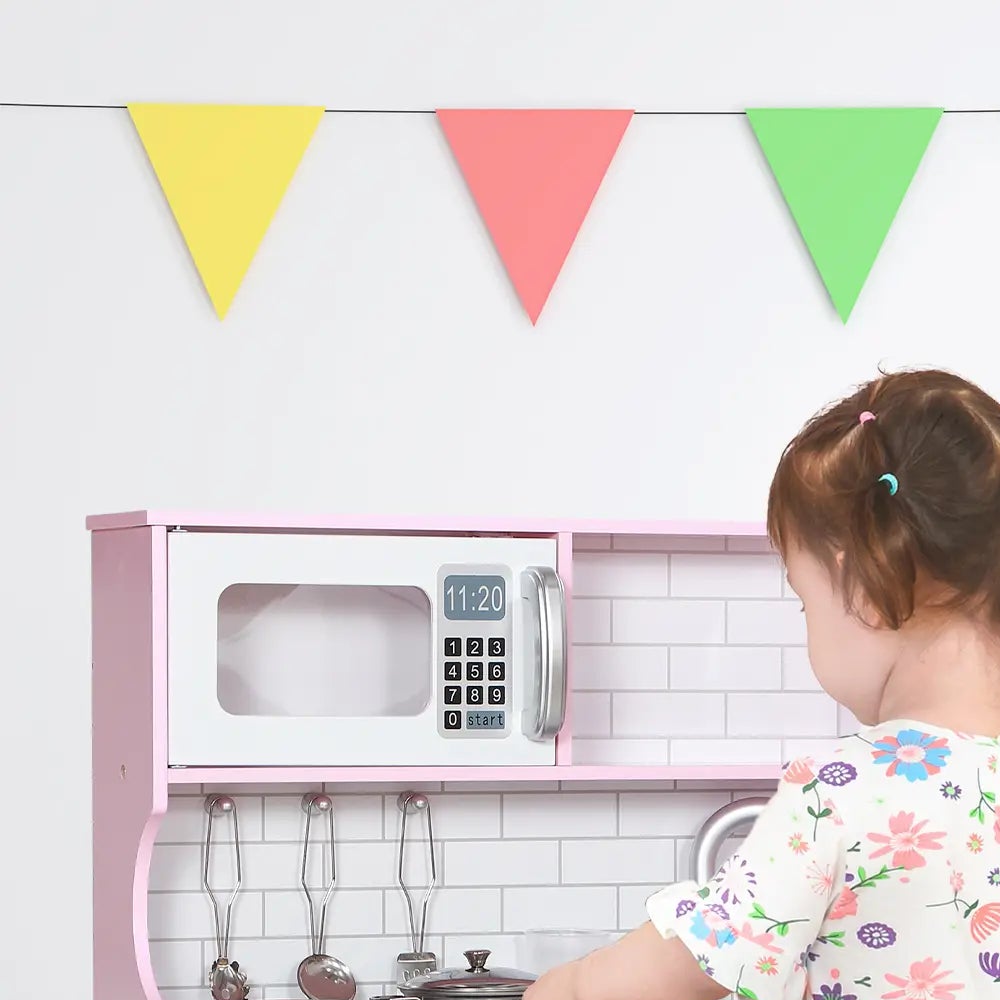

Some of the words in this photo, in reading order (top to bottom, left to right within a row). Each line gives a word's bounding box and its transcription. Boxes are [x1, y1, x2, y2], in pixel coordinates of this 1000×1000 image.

[446, 585, 503, 611] 11:20
[449, 640, 456, 654] 1
[470, 640, 479, 654] 2
[492, 640, 502, 654] 3
[448, 664, 458, 678] 4
[470, 664, 480, 678] 5
[492, 664, 502, 678] 6
[448, 688, 458, 702] 7
[470, 688, 480, 702] 8
[492, 688, 502, 702] 9
[448, 712, 458, 726] 0
[468, 713, 504, 726] start
